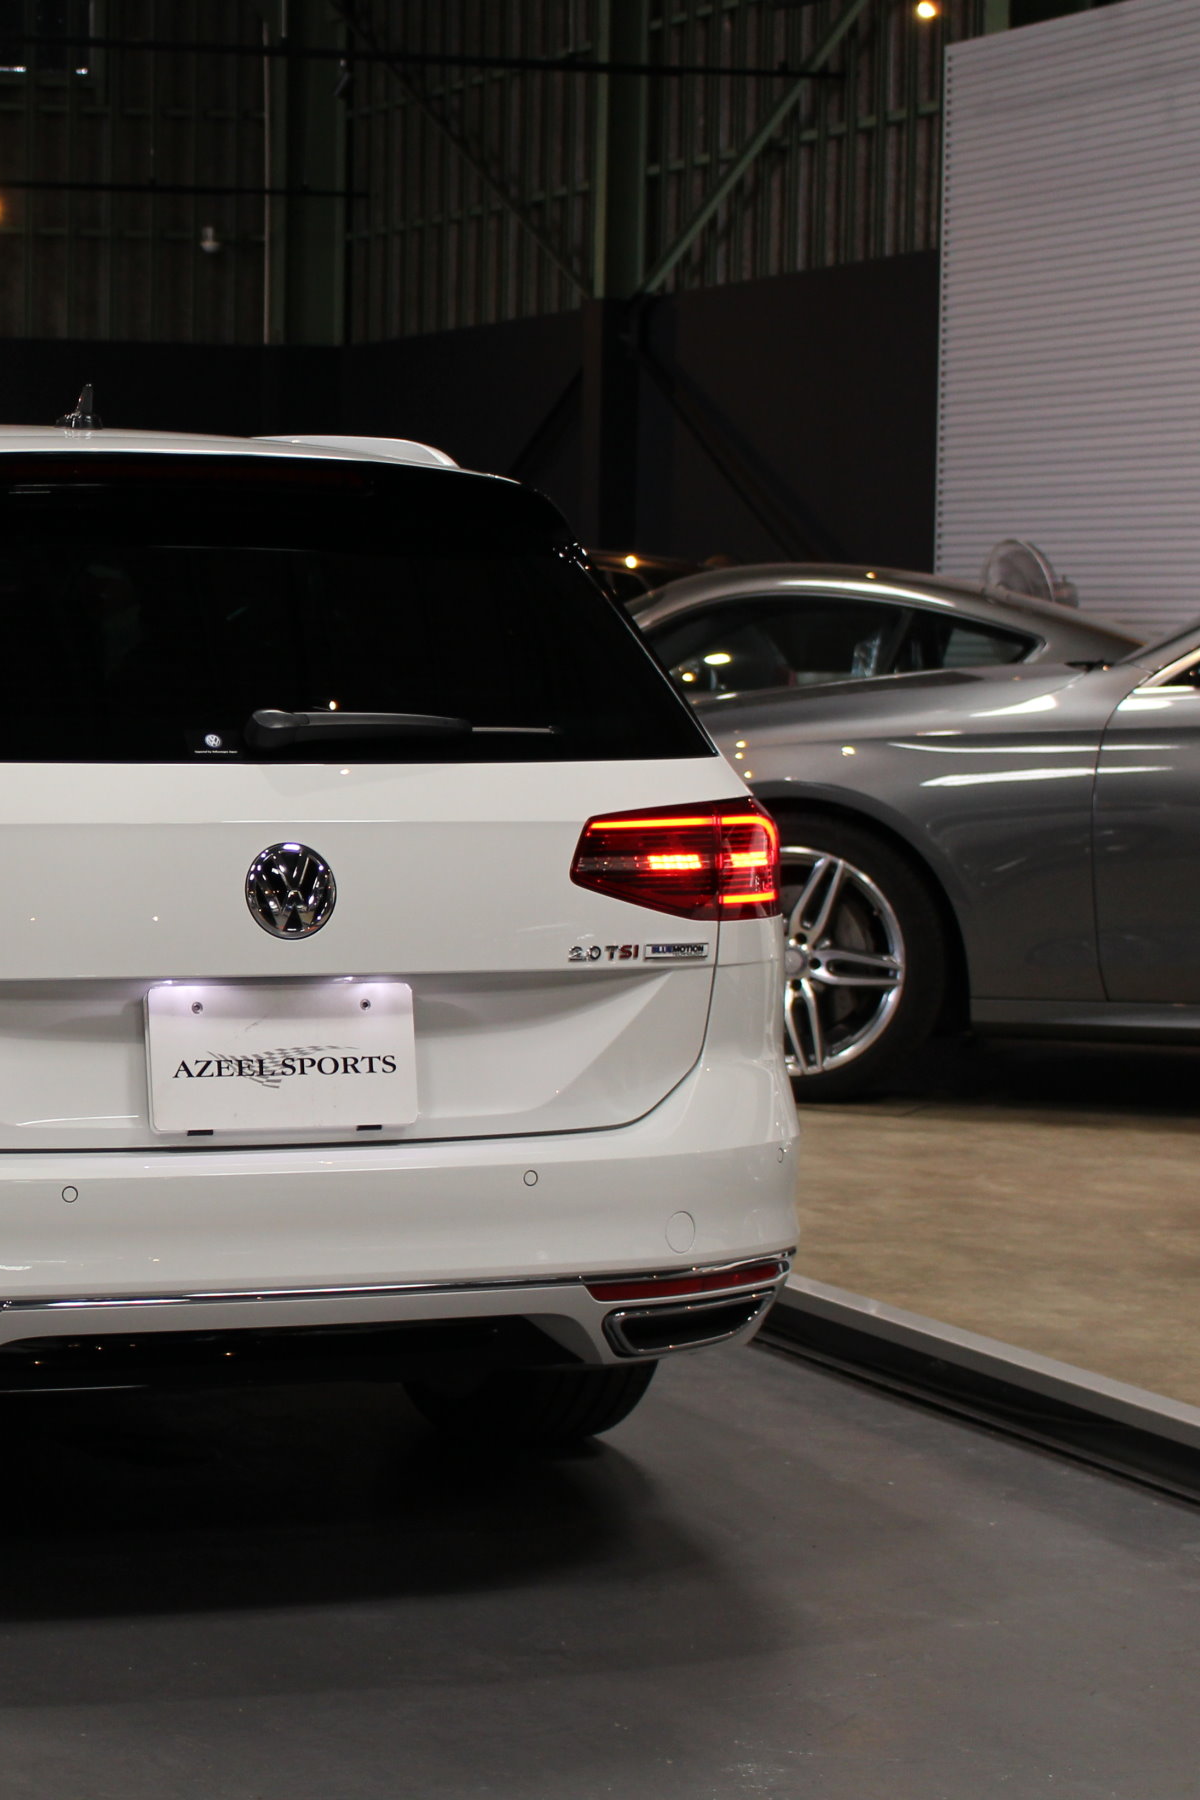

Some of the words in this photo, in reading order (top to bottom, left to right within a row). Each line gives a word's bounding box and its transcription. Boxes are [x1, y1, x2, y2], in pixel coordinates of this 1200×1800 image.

[605, 944, 640, 960] TSI
[172, 1058, 276, 1079] AZEEL
[281, 1054, 398, 1076] SPORTS
